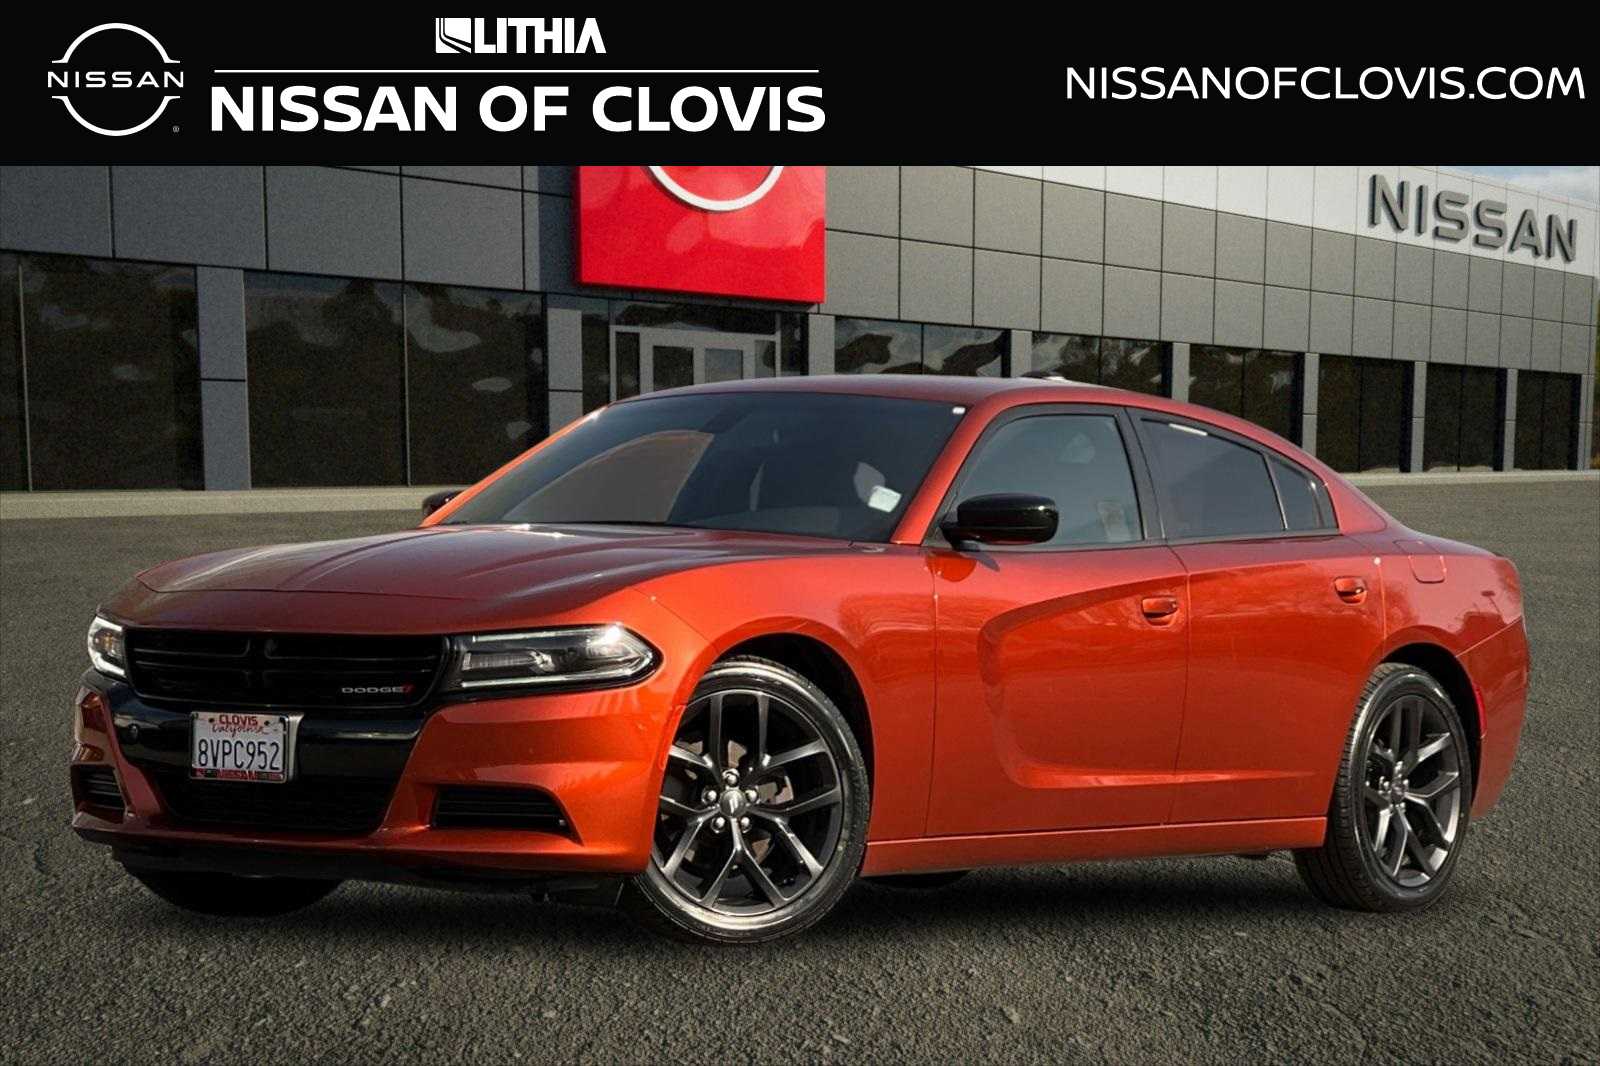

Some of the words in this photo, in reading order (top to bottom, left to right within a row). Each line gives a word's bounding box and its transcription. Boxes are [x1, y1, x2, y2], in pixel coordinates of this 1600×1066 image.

[1368, 174, 1578, 263] NISSAN
[341, 686, 403, 694] DODGE
[219, 714, 258, 726] CLOVIS
[198, 739, 280, 771] 8VPC952
